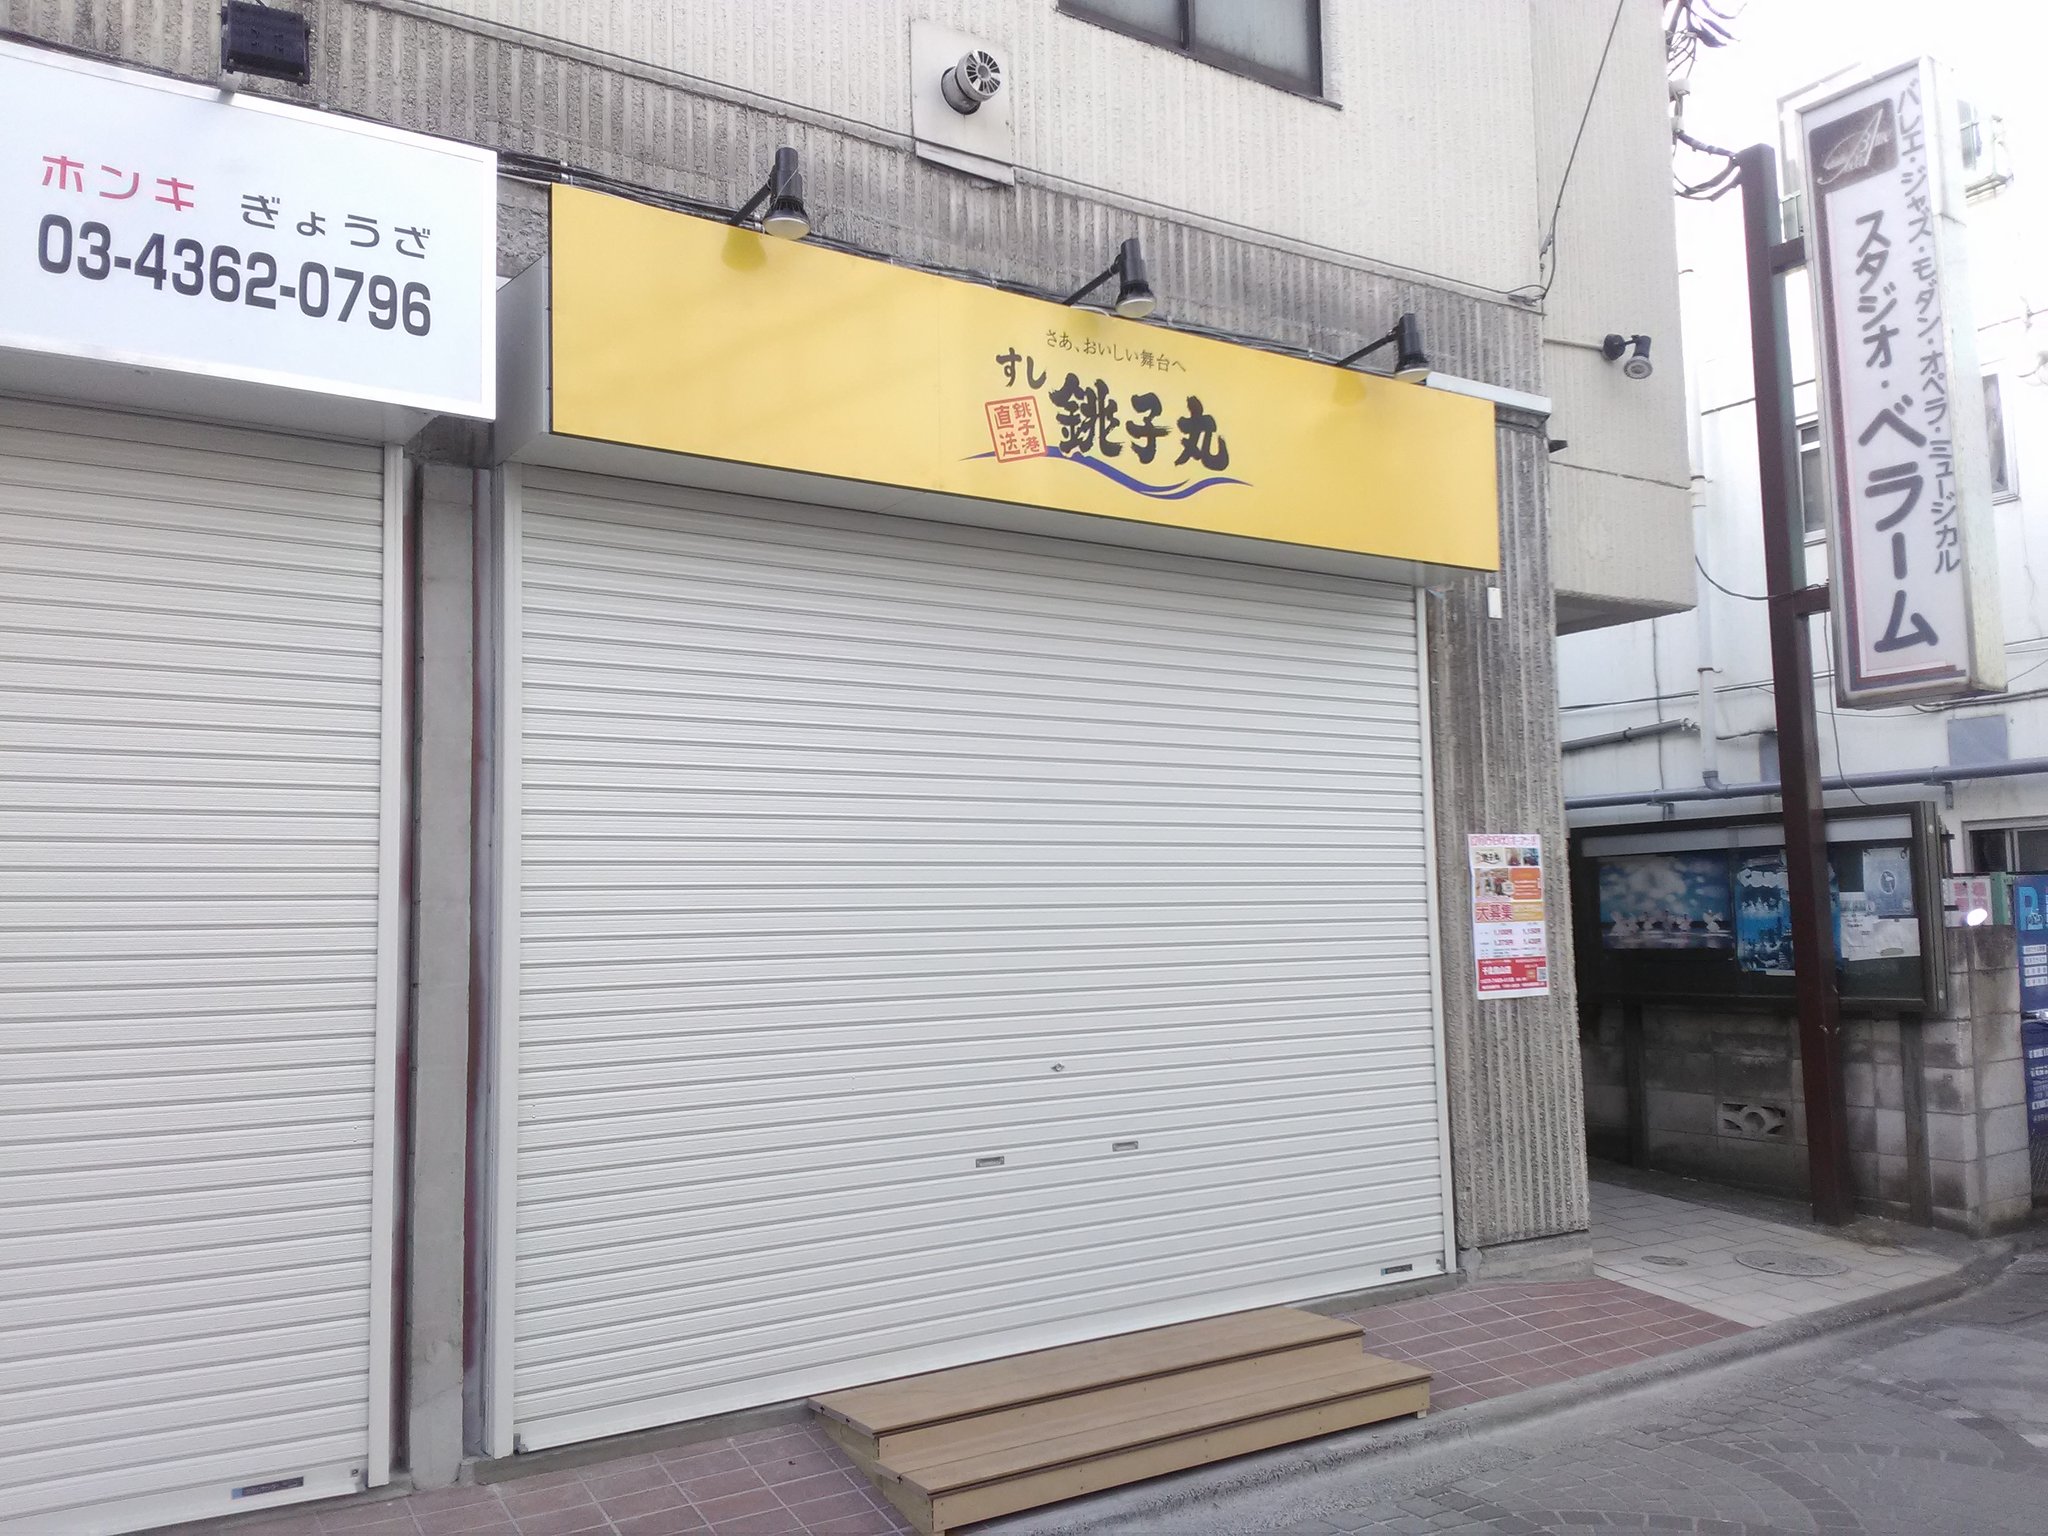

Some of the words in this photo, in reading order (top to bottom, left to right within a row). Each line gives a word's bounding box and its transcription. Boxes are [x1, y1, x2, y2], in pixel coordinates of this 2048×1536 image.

[41, 155, 196, 212] ホンキ
[240, 193, 432, 260] ぎょうざ
[37, 213, 432, 337] 03-4362-0796
[1045, 328, 1187, 374] さあ、おいしい舞台へ
[1897, 78, 1960, 575] バレエ・ジャズ・モダン・オペラ・ミュージカル
[996, 346, 1048, 391] すし
[993, 404, 1021, 458] 直送
[1012, 401, 1041, 455] 銚子港
[1047, 371, 1231, 472] 銚子丸
[1855, 209, 1939, 653] スタジオ・ベラーム
[1476, 903, 1513, 921] 大募集
